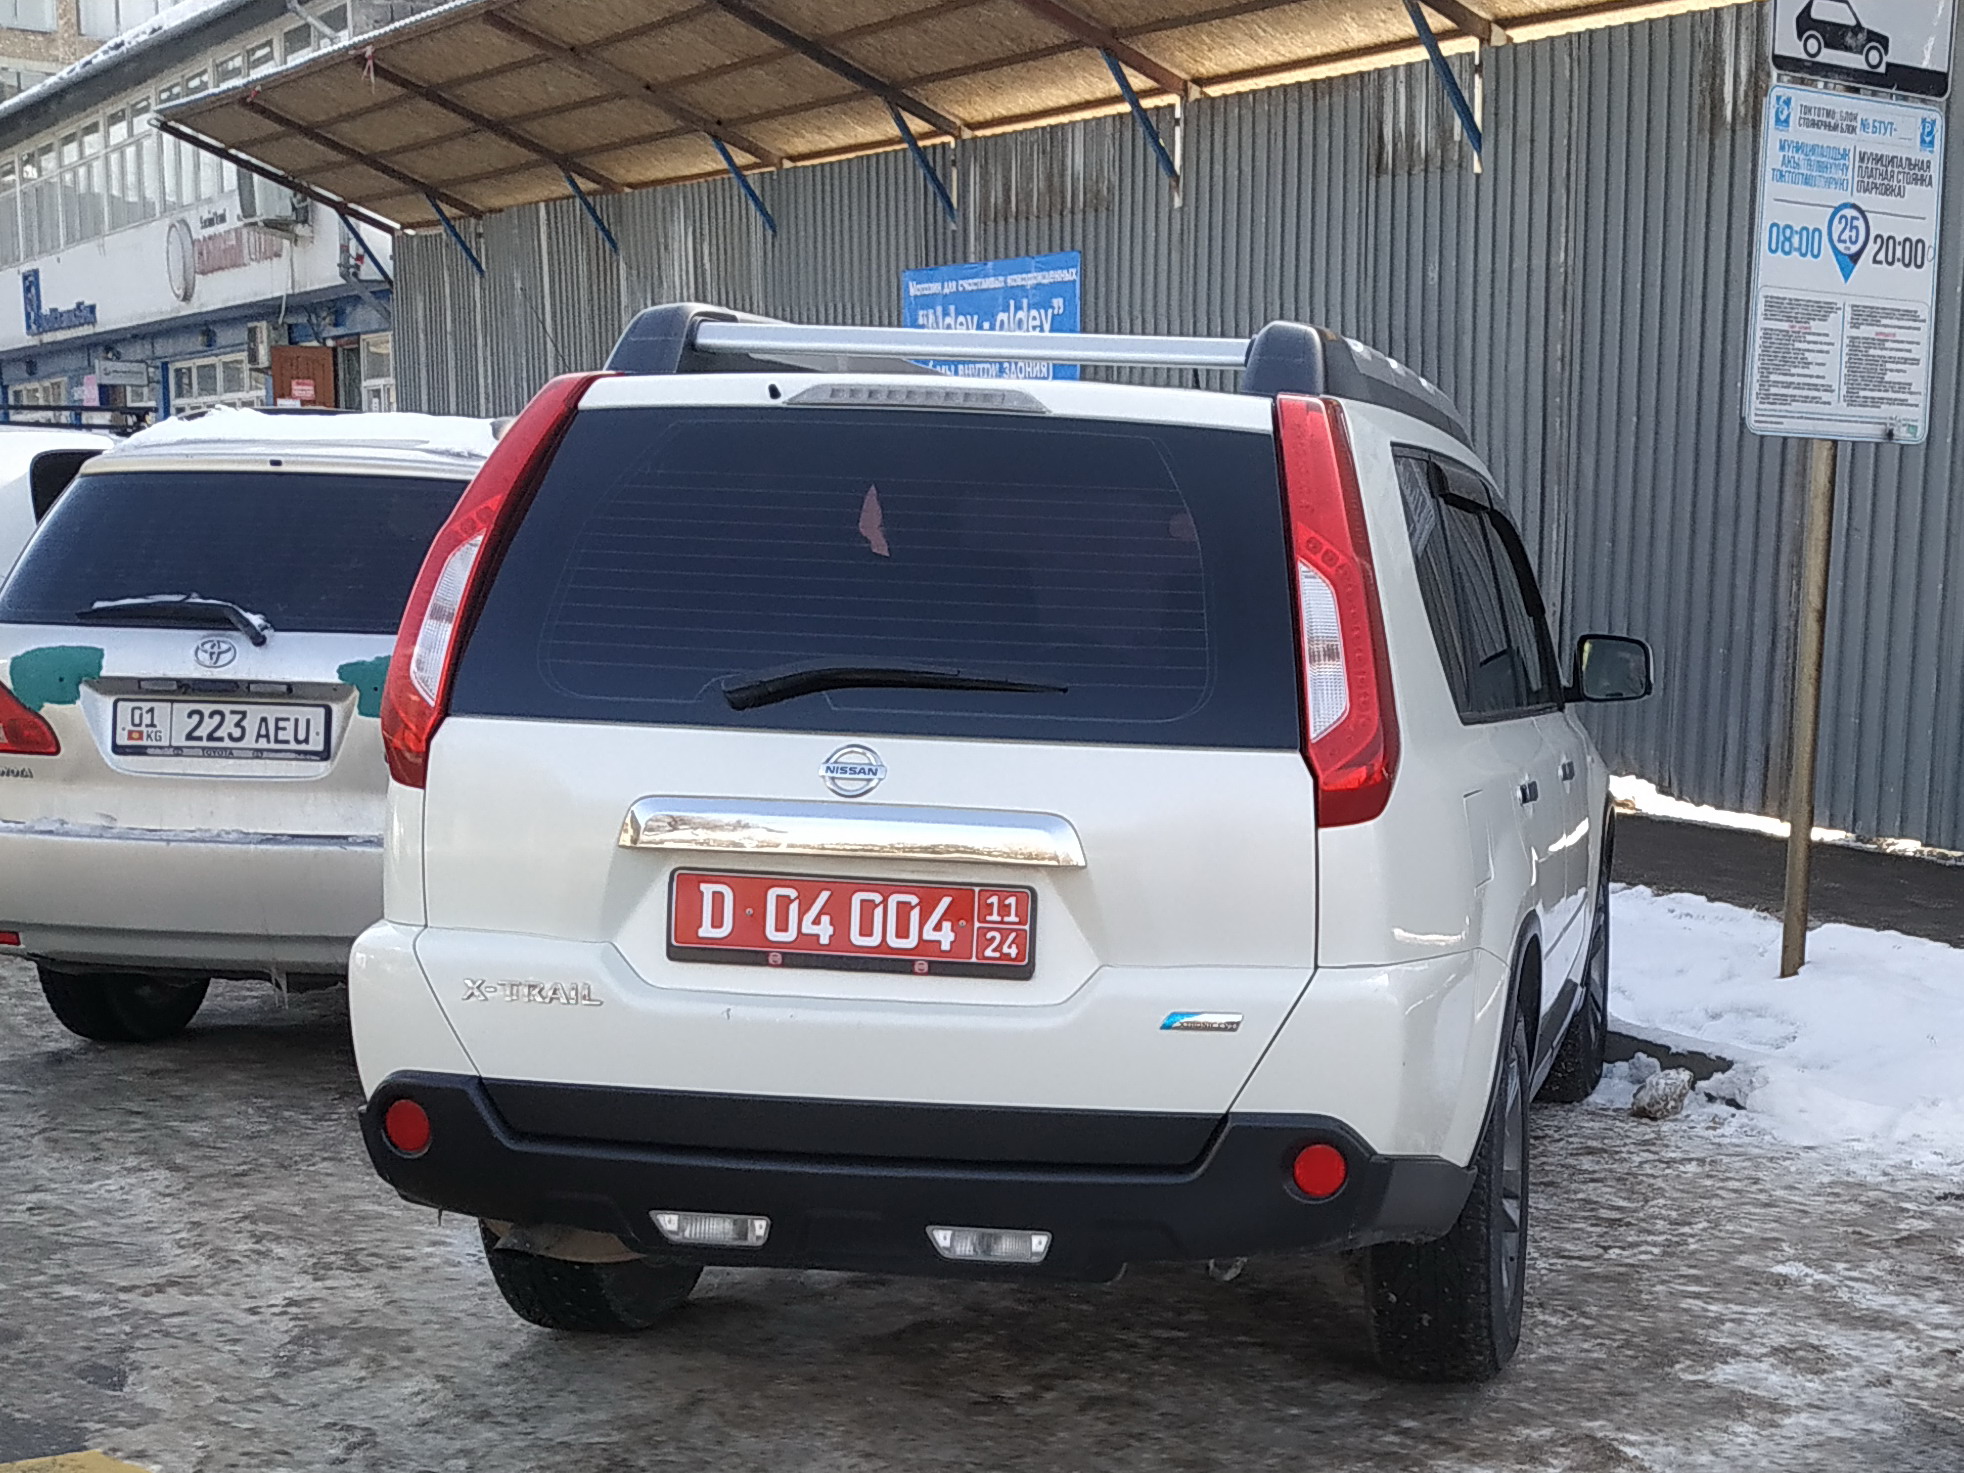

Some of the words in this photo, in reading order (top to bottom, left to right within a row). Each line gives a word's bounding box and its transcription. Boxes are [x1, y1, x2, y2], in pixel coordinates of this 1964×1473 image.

[1858, 150, 1932, 174] МУНИЦИПАЛЬНАЯ
[1856, 179, 1906, 198] (ПАРКОВКА)
[1857, 164, 1895, 183] ПЛАТНАЯ
[1896, 170, 1933, 188] СТОЯНКА
[1767, 222, 1823, 259] 08:00
[1837, 214, 1860, 246] 25
[1872, 233, 1926, 269] 20:00
[130, 705, 158, 729] 01
[185, 708, 248, 743] 223
[254, 716, 311, 746] AEU
[146, 729, 163, 743] KG
[825, 765, 879, 777] NISSAN
[698, 882, 735, 938] D
[765, 886, 834, 945] 04
[850, 891, 955, 951] 004
[985, 895, 1020, 922] 11
[984, 931, 1019, 960] 24
[461, 978, 604, 1006] X-TRAIL
